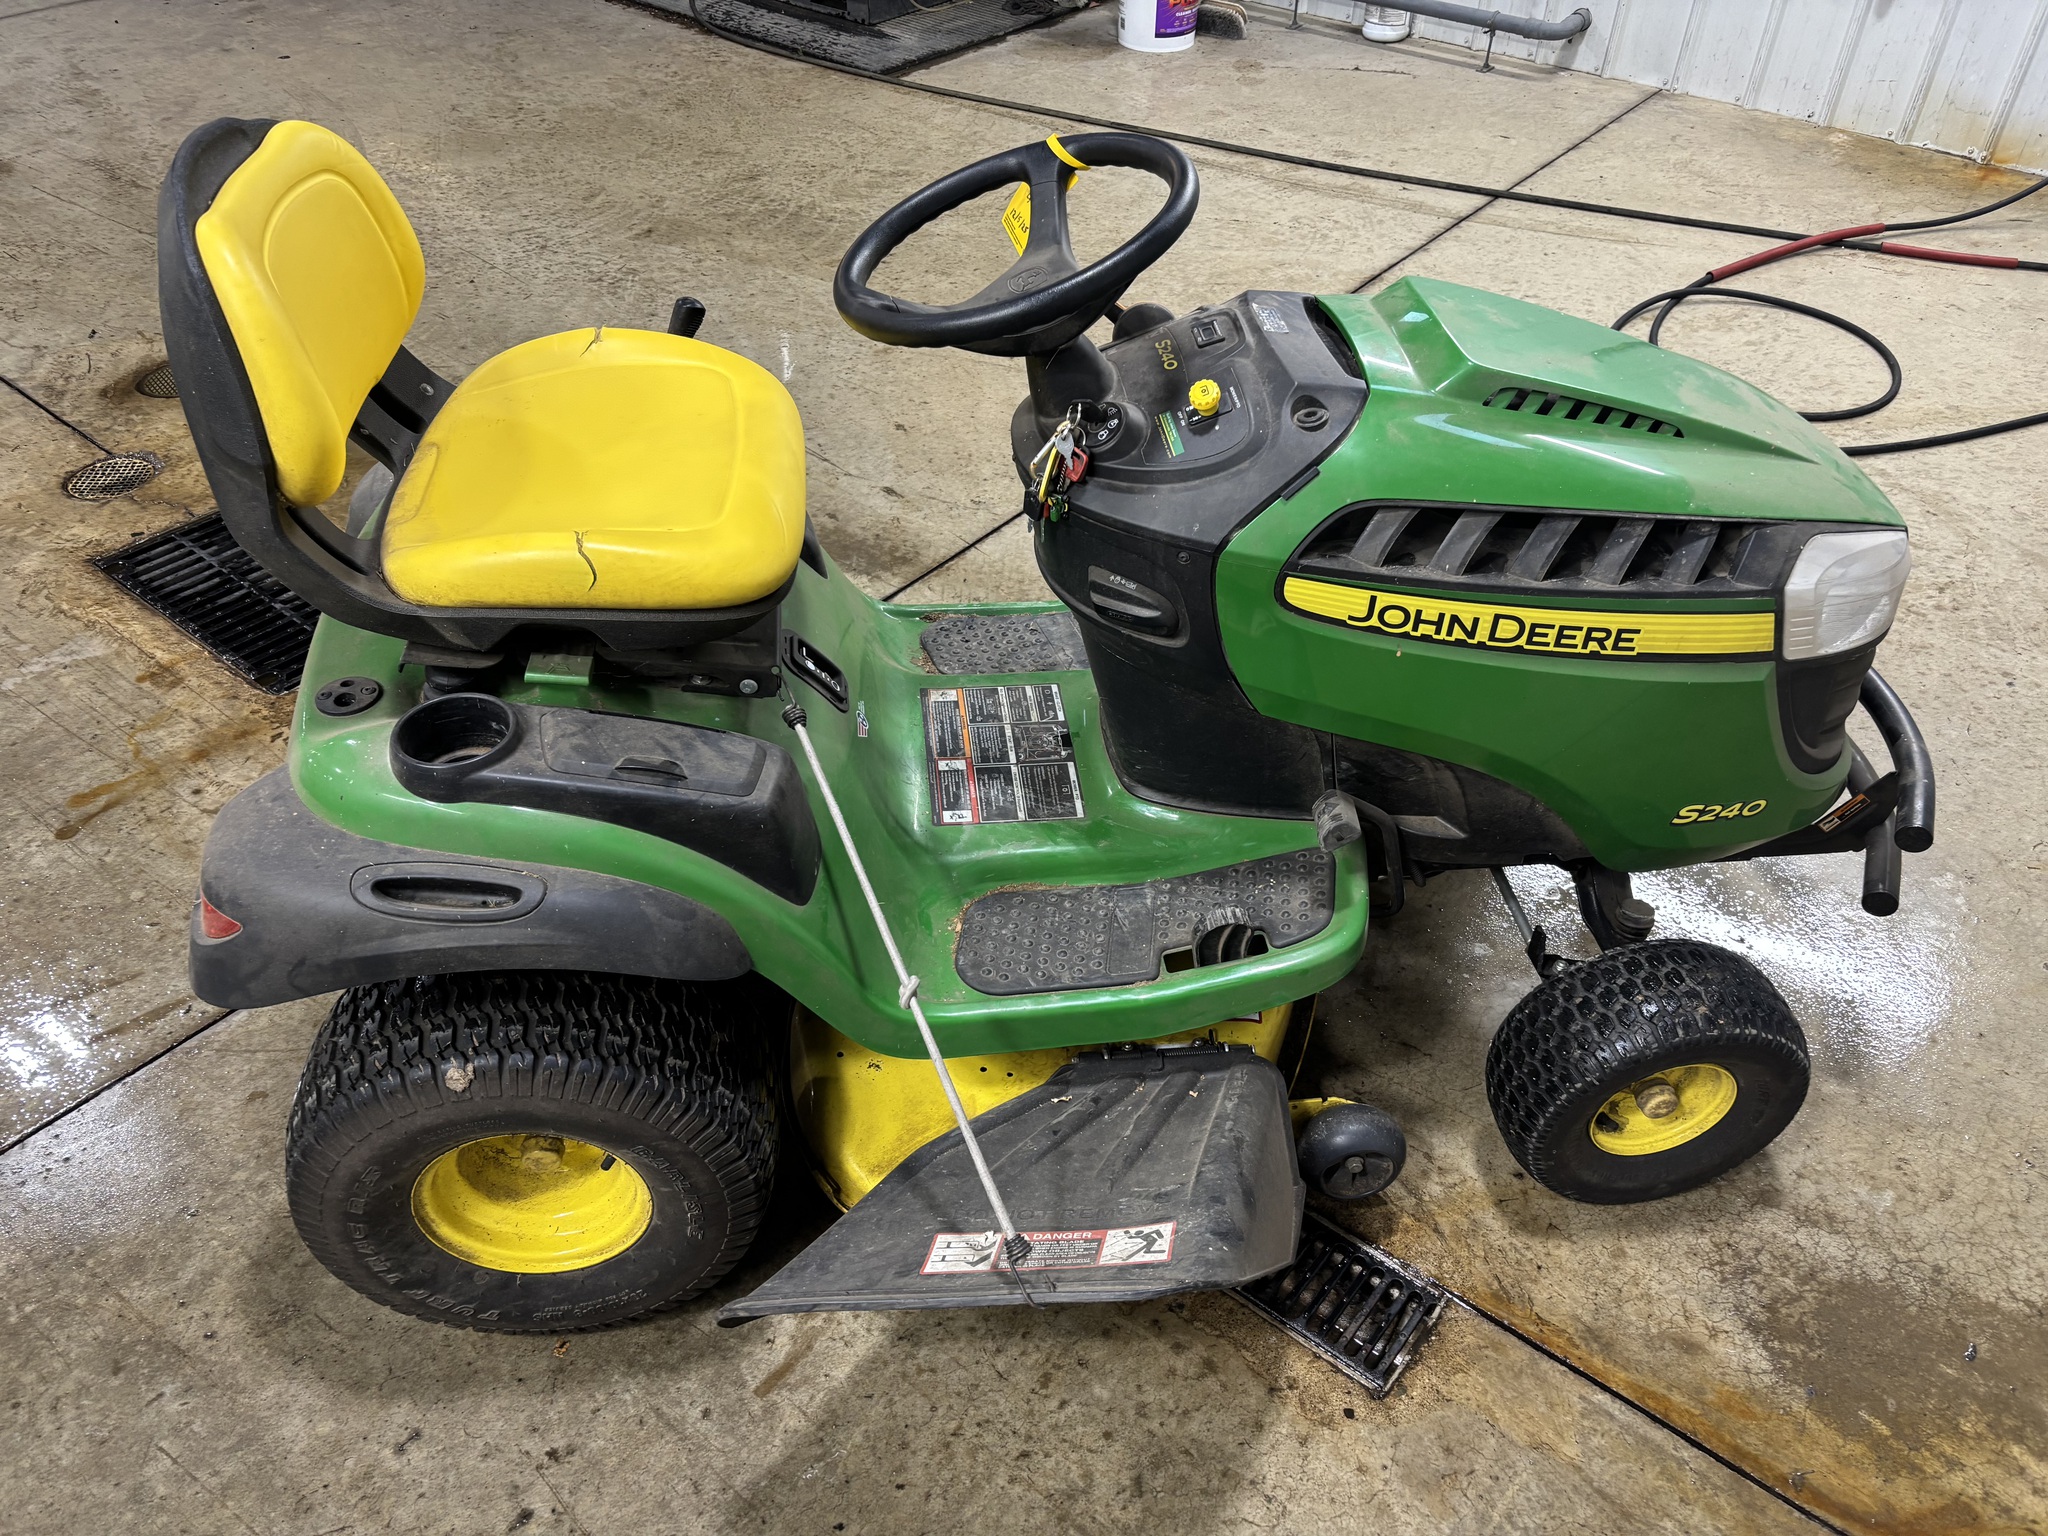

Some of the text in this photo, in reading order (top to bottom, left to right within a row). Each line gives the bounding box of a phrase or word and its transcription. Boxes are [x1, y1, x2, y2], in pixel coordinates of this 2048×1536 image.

[1155, 340, 1178, 370] S240
[1348, 595, 1641, 652] JOHN DEERE
[1670, 799, 1768, 825] S240
[630, 1145, 704, 1240] CARLISLE
